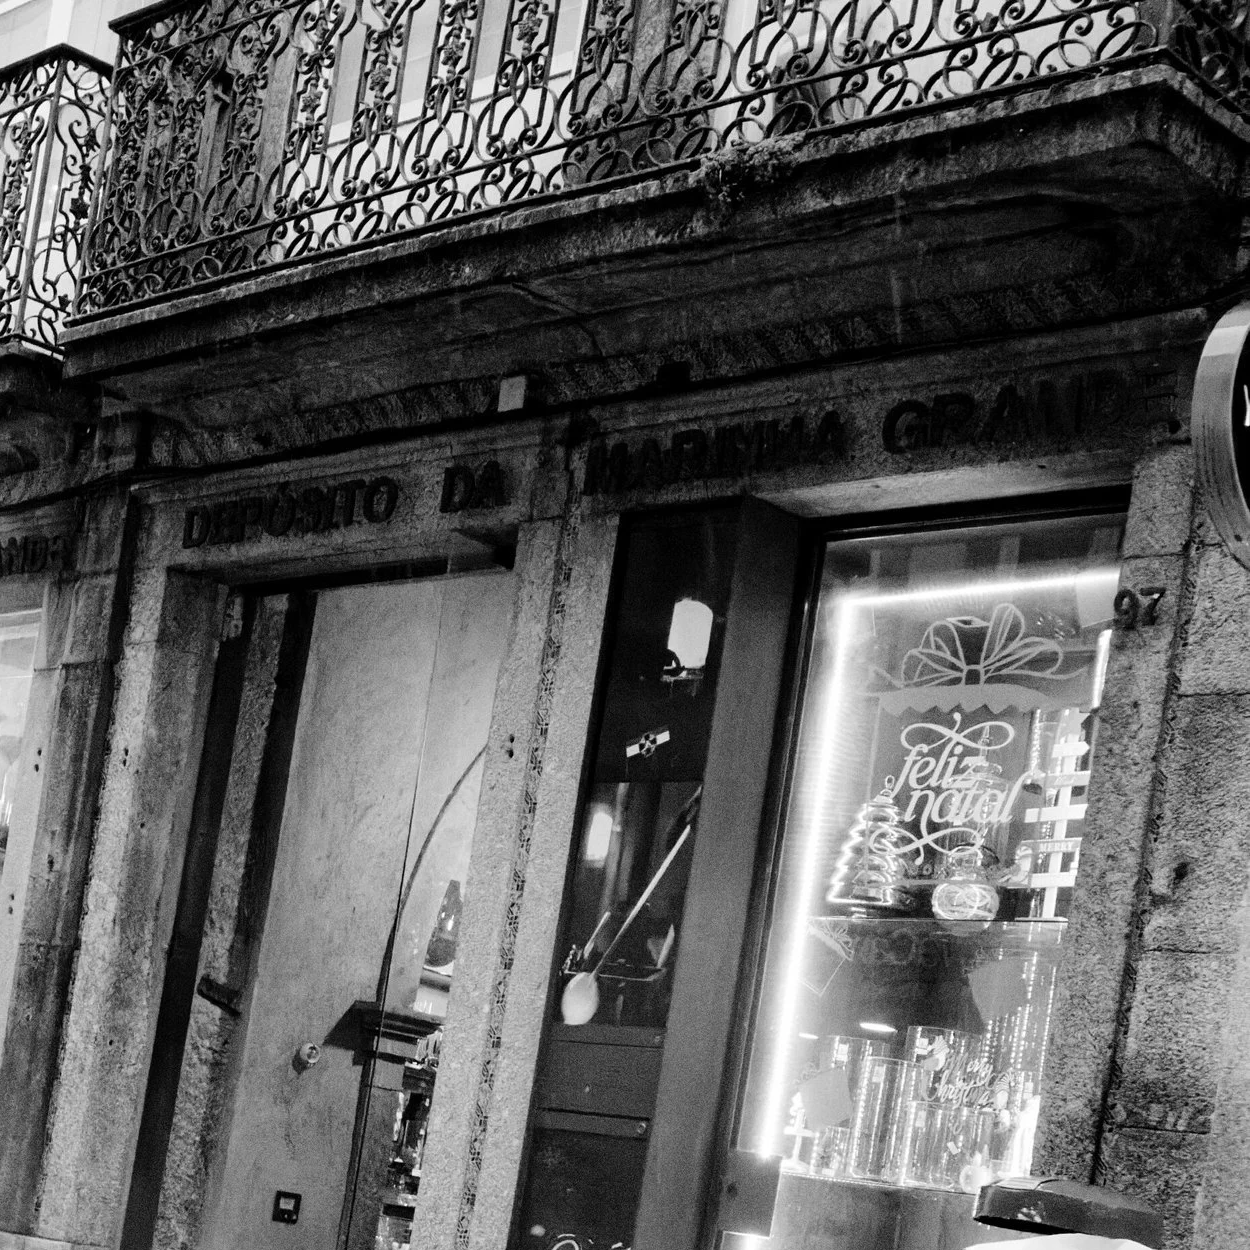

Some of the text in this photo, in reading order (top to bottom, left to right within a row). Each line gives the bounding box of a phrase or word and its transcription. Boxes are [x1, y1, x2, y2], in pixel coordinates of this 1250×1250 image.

[182, 476, 399, 549] DEPÓSITO
[440, 460, 511, 513] DA
[584, 410, 847, 496] MARINHA
[1113, 586, 1166, 630] 97
[891, 738, 993, 799] feliz
[904, 771, 1034, 825] natal
